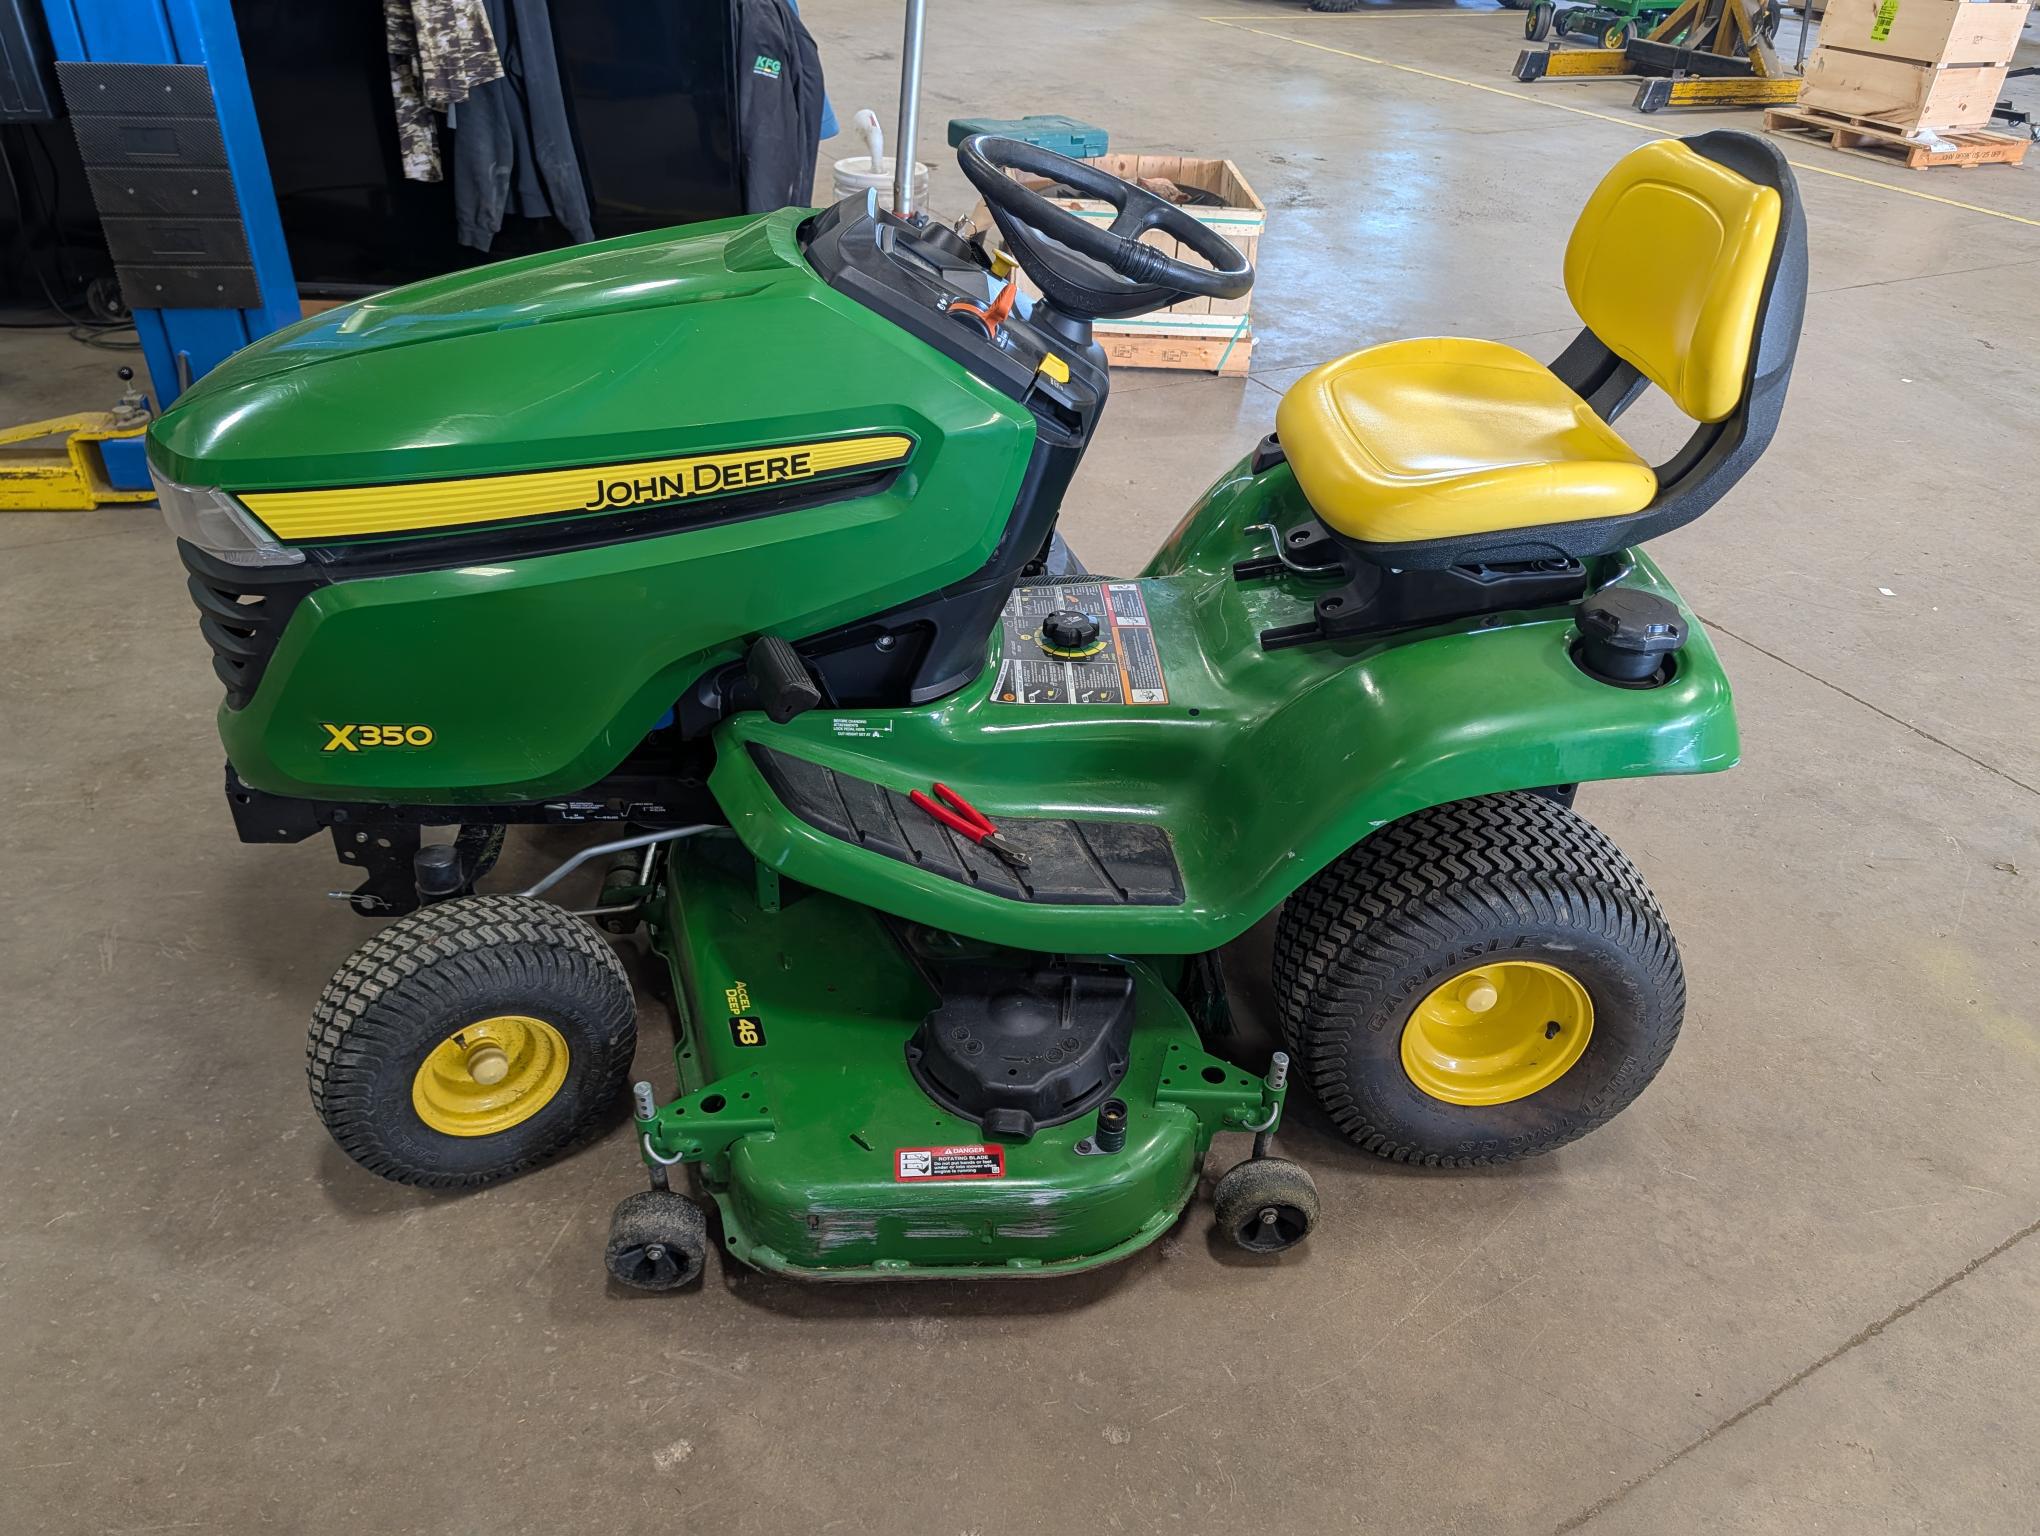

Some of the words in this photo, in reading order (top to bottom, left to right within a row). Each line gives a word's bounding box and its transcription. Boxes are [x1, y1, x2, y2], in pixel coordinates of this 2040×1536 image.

[586, 473, 685, 507] JOHN
[694, 453, 811, 491] DEERE
[322, 724, 433, 751] X350
[735, 981, 751, 1011] ACCEL
[1366, 933, 1540, 1033] CARLISLE
[725, 989, 740, 1015] DEEP
[737, 1019, 758, 1044] 48
